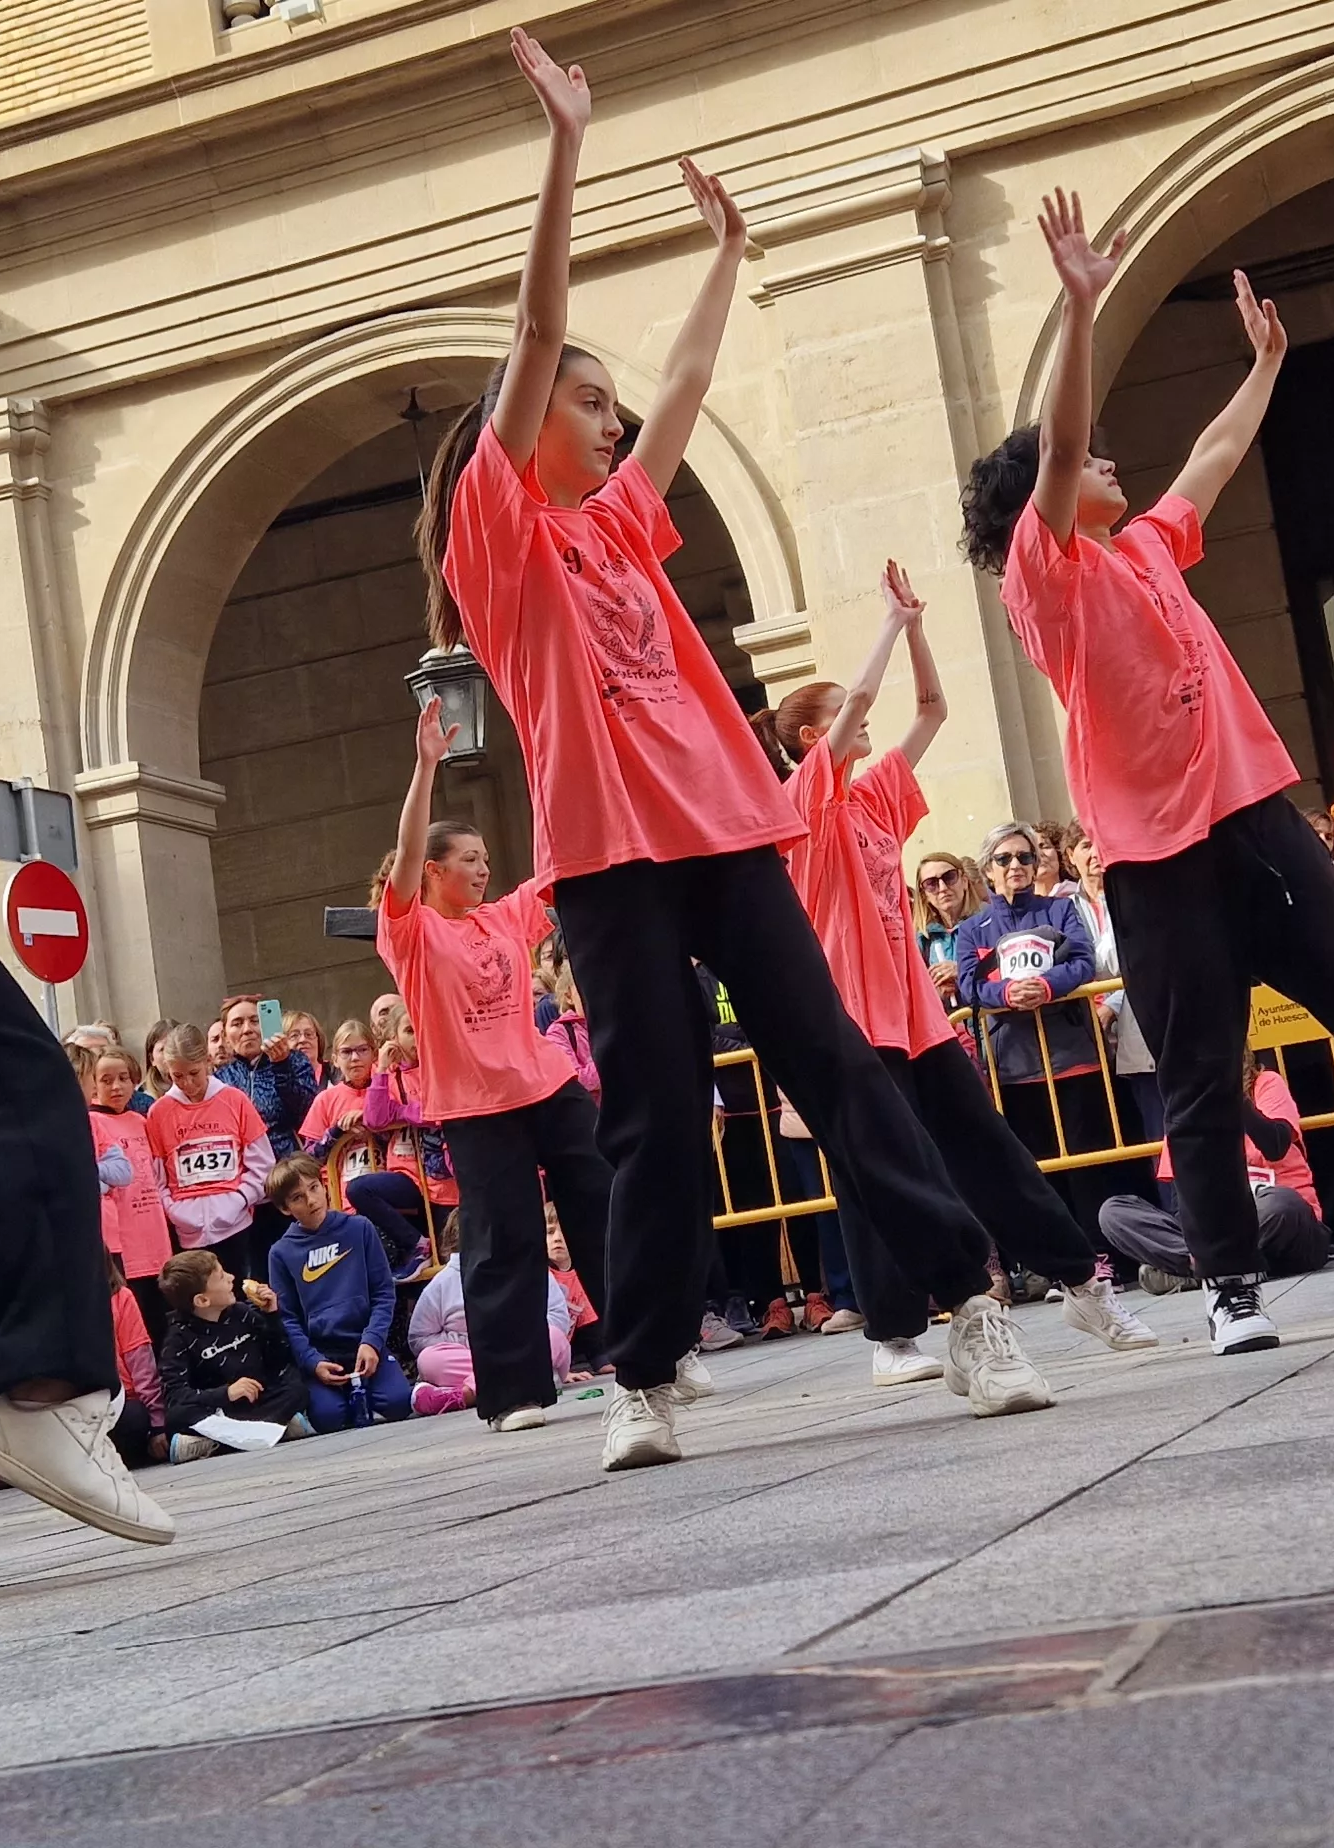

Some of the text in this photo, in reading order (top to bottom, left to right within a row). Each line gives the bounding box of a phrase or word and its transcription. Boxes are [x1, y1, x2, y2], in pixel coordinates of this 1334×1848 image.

[1010, 951, 1043, 974] 900
[1259, 1012, 1309, 1027] de Huesca
[181, 1152, 231, 1173] 1437
[308, 1243, 340, 1268] NIKE
[201, 1333, 251, 1360] Champion
